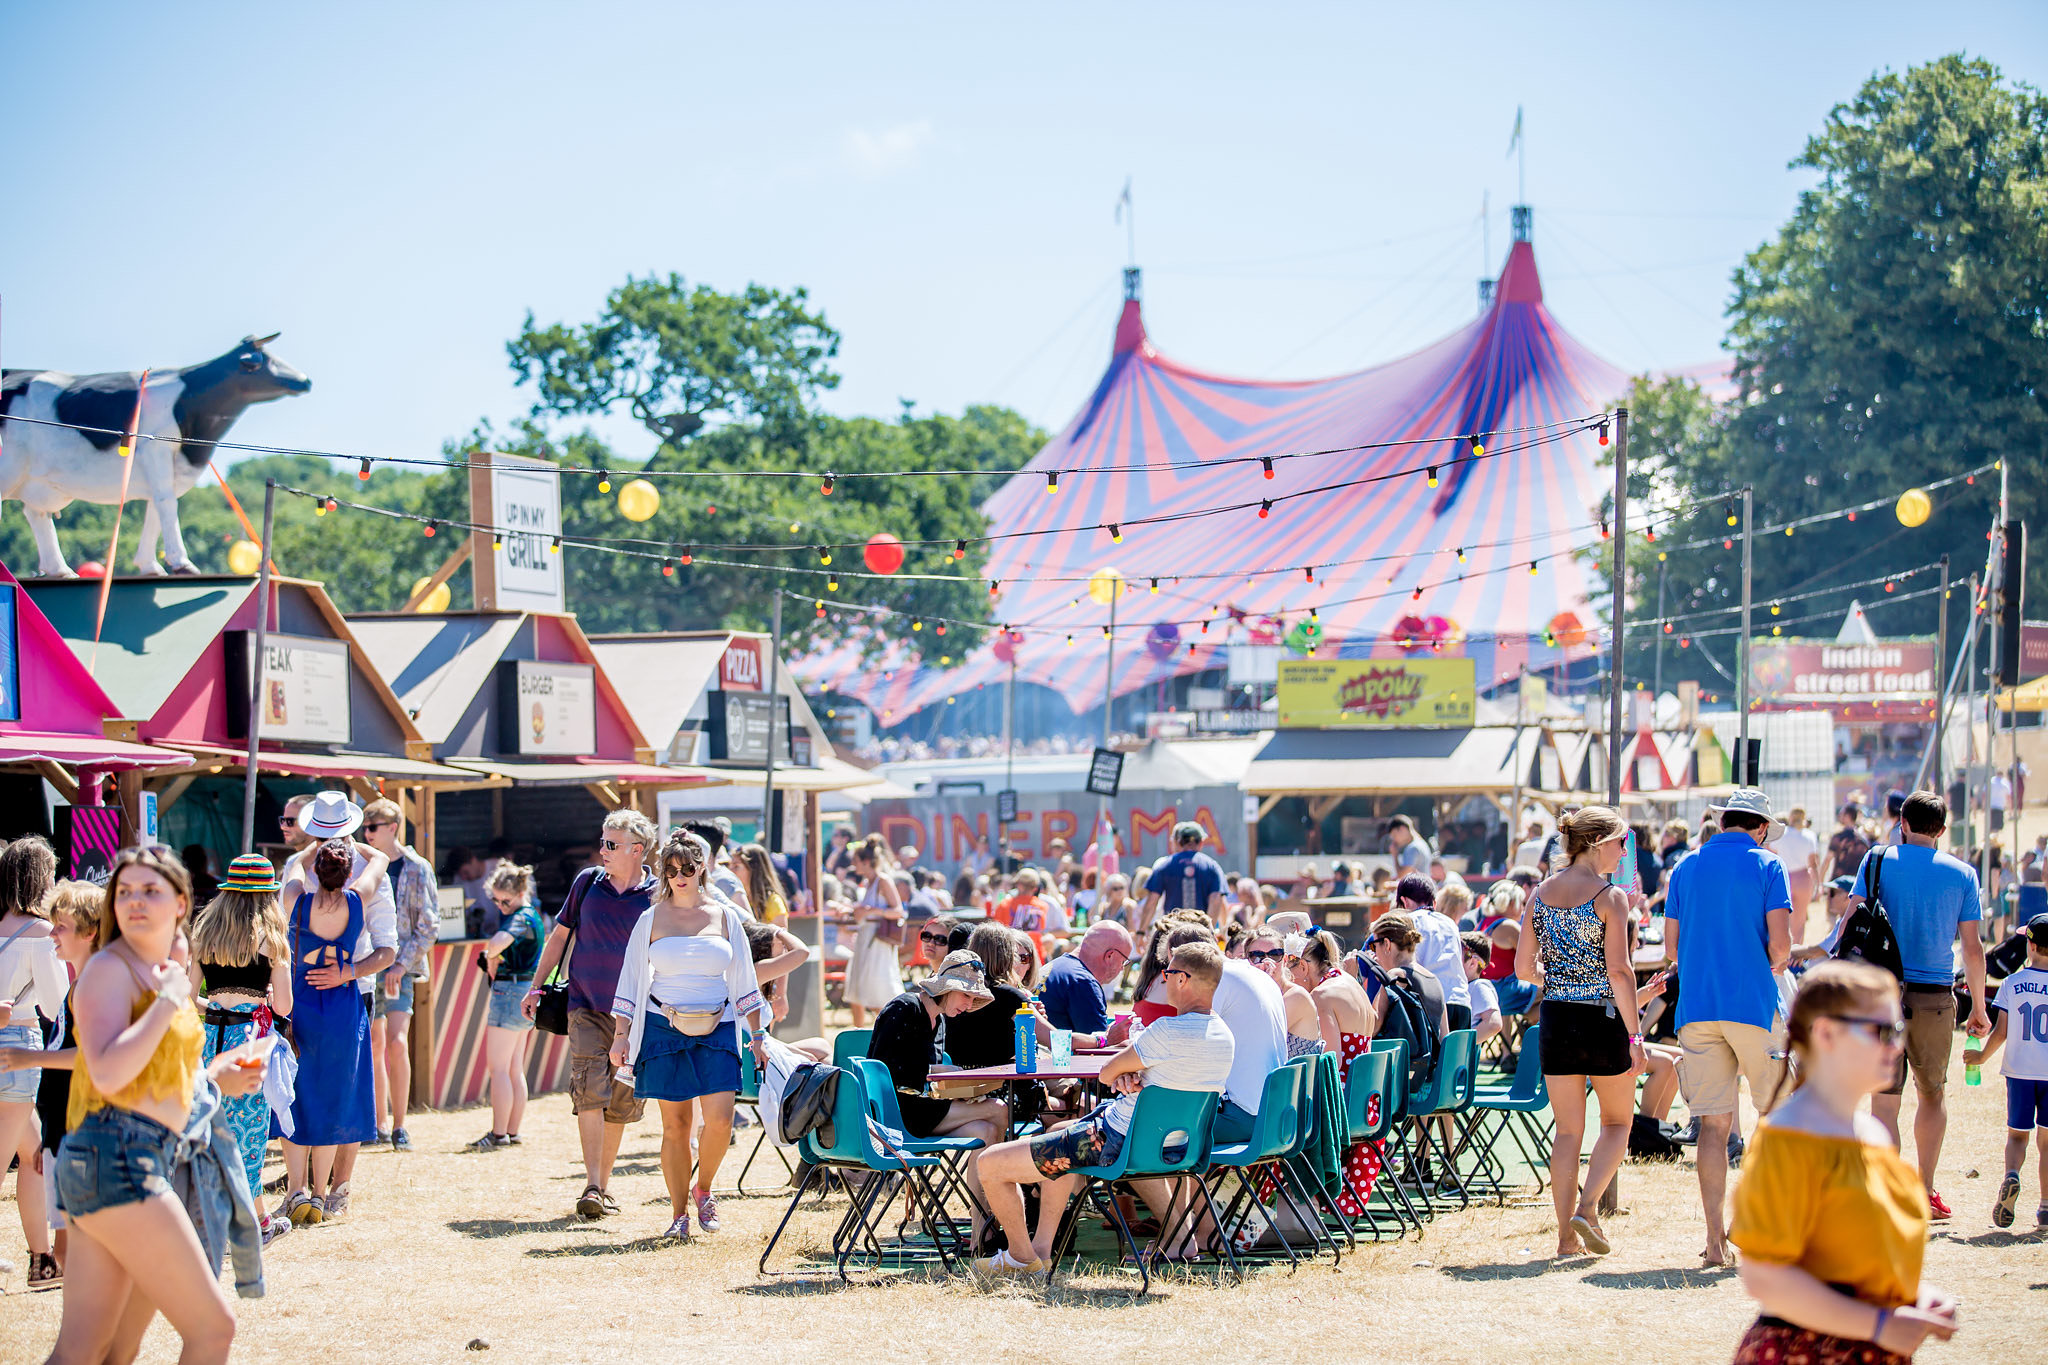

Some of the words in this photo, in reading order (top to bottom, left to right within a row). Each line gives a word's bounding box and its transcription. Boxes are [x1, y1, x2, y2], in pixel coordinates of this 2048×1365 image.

[505, 502, 518, 524] UP
[520, 504, 530, 526] IN
[531, 505, 545, 528] MY
[507, 530, 547, 571] GRILL
[263, 646, 293, 673] TEAK
[725, 646, 759, 684] PIZZA
[521, 673, 554, 696] BURGER
[1794, 672, 1870, 693] street
[1874, 669, 1931, 692] food
[85, 865, 107, 881] Club
[439, 905, 463, 920] OLLECT
[2018, 1001, 2048, 1043] 10
